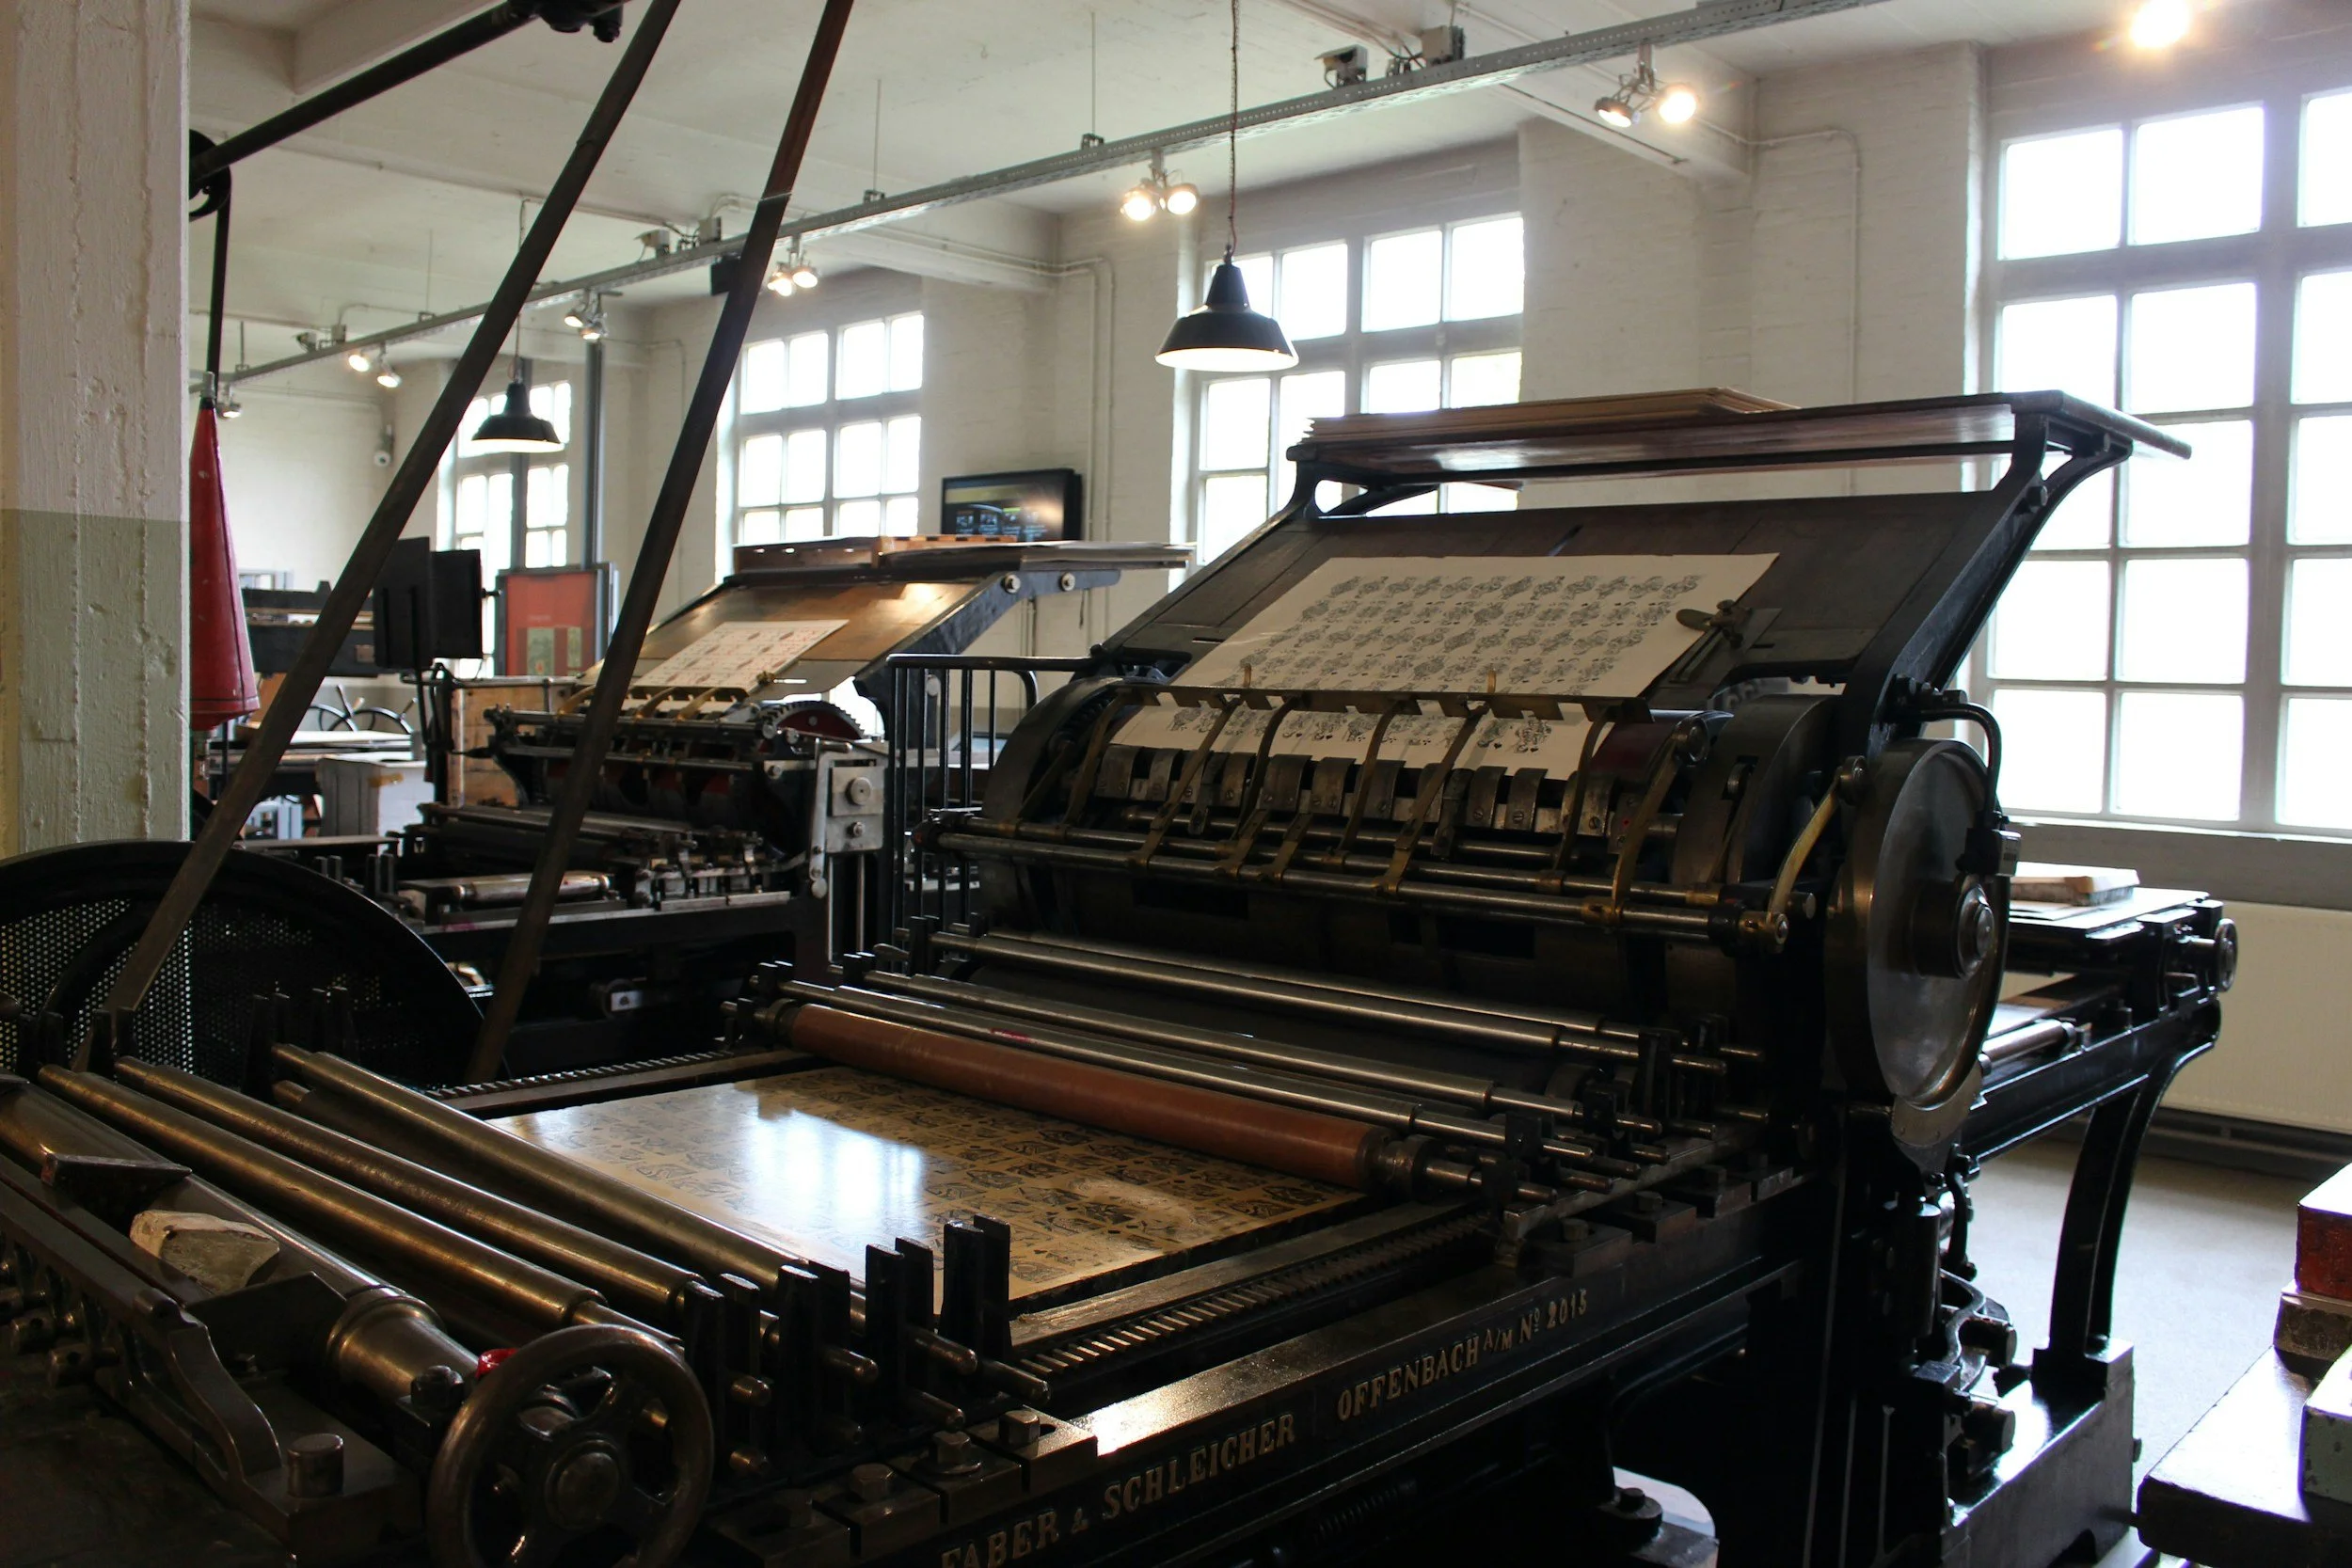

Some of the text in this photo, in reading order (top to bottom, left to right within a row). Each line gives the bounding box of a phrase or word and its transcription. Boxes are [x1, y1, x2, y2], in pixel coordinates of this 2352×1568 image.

[1102, 1413, 1295, 1520] SCHLEICHER
[1336, 1334, 1480, 1422] OFFENBACH
[1547, 1288, 1587, 1329] 2015
